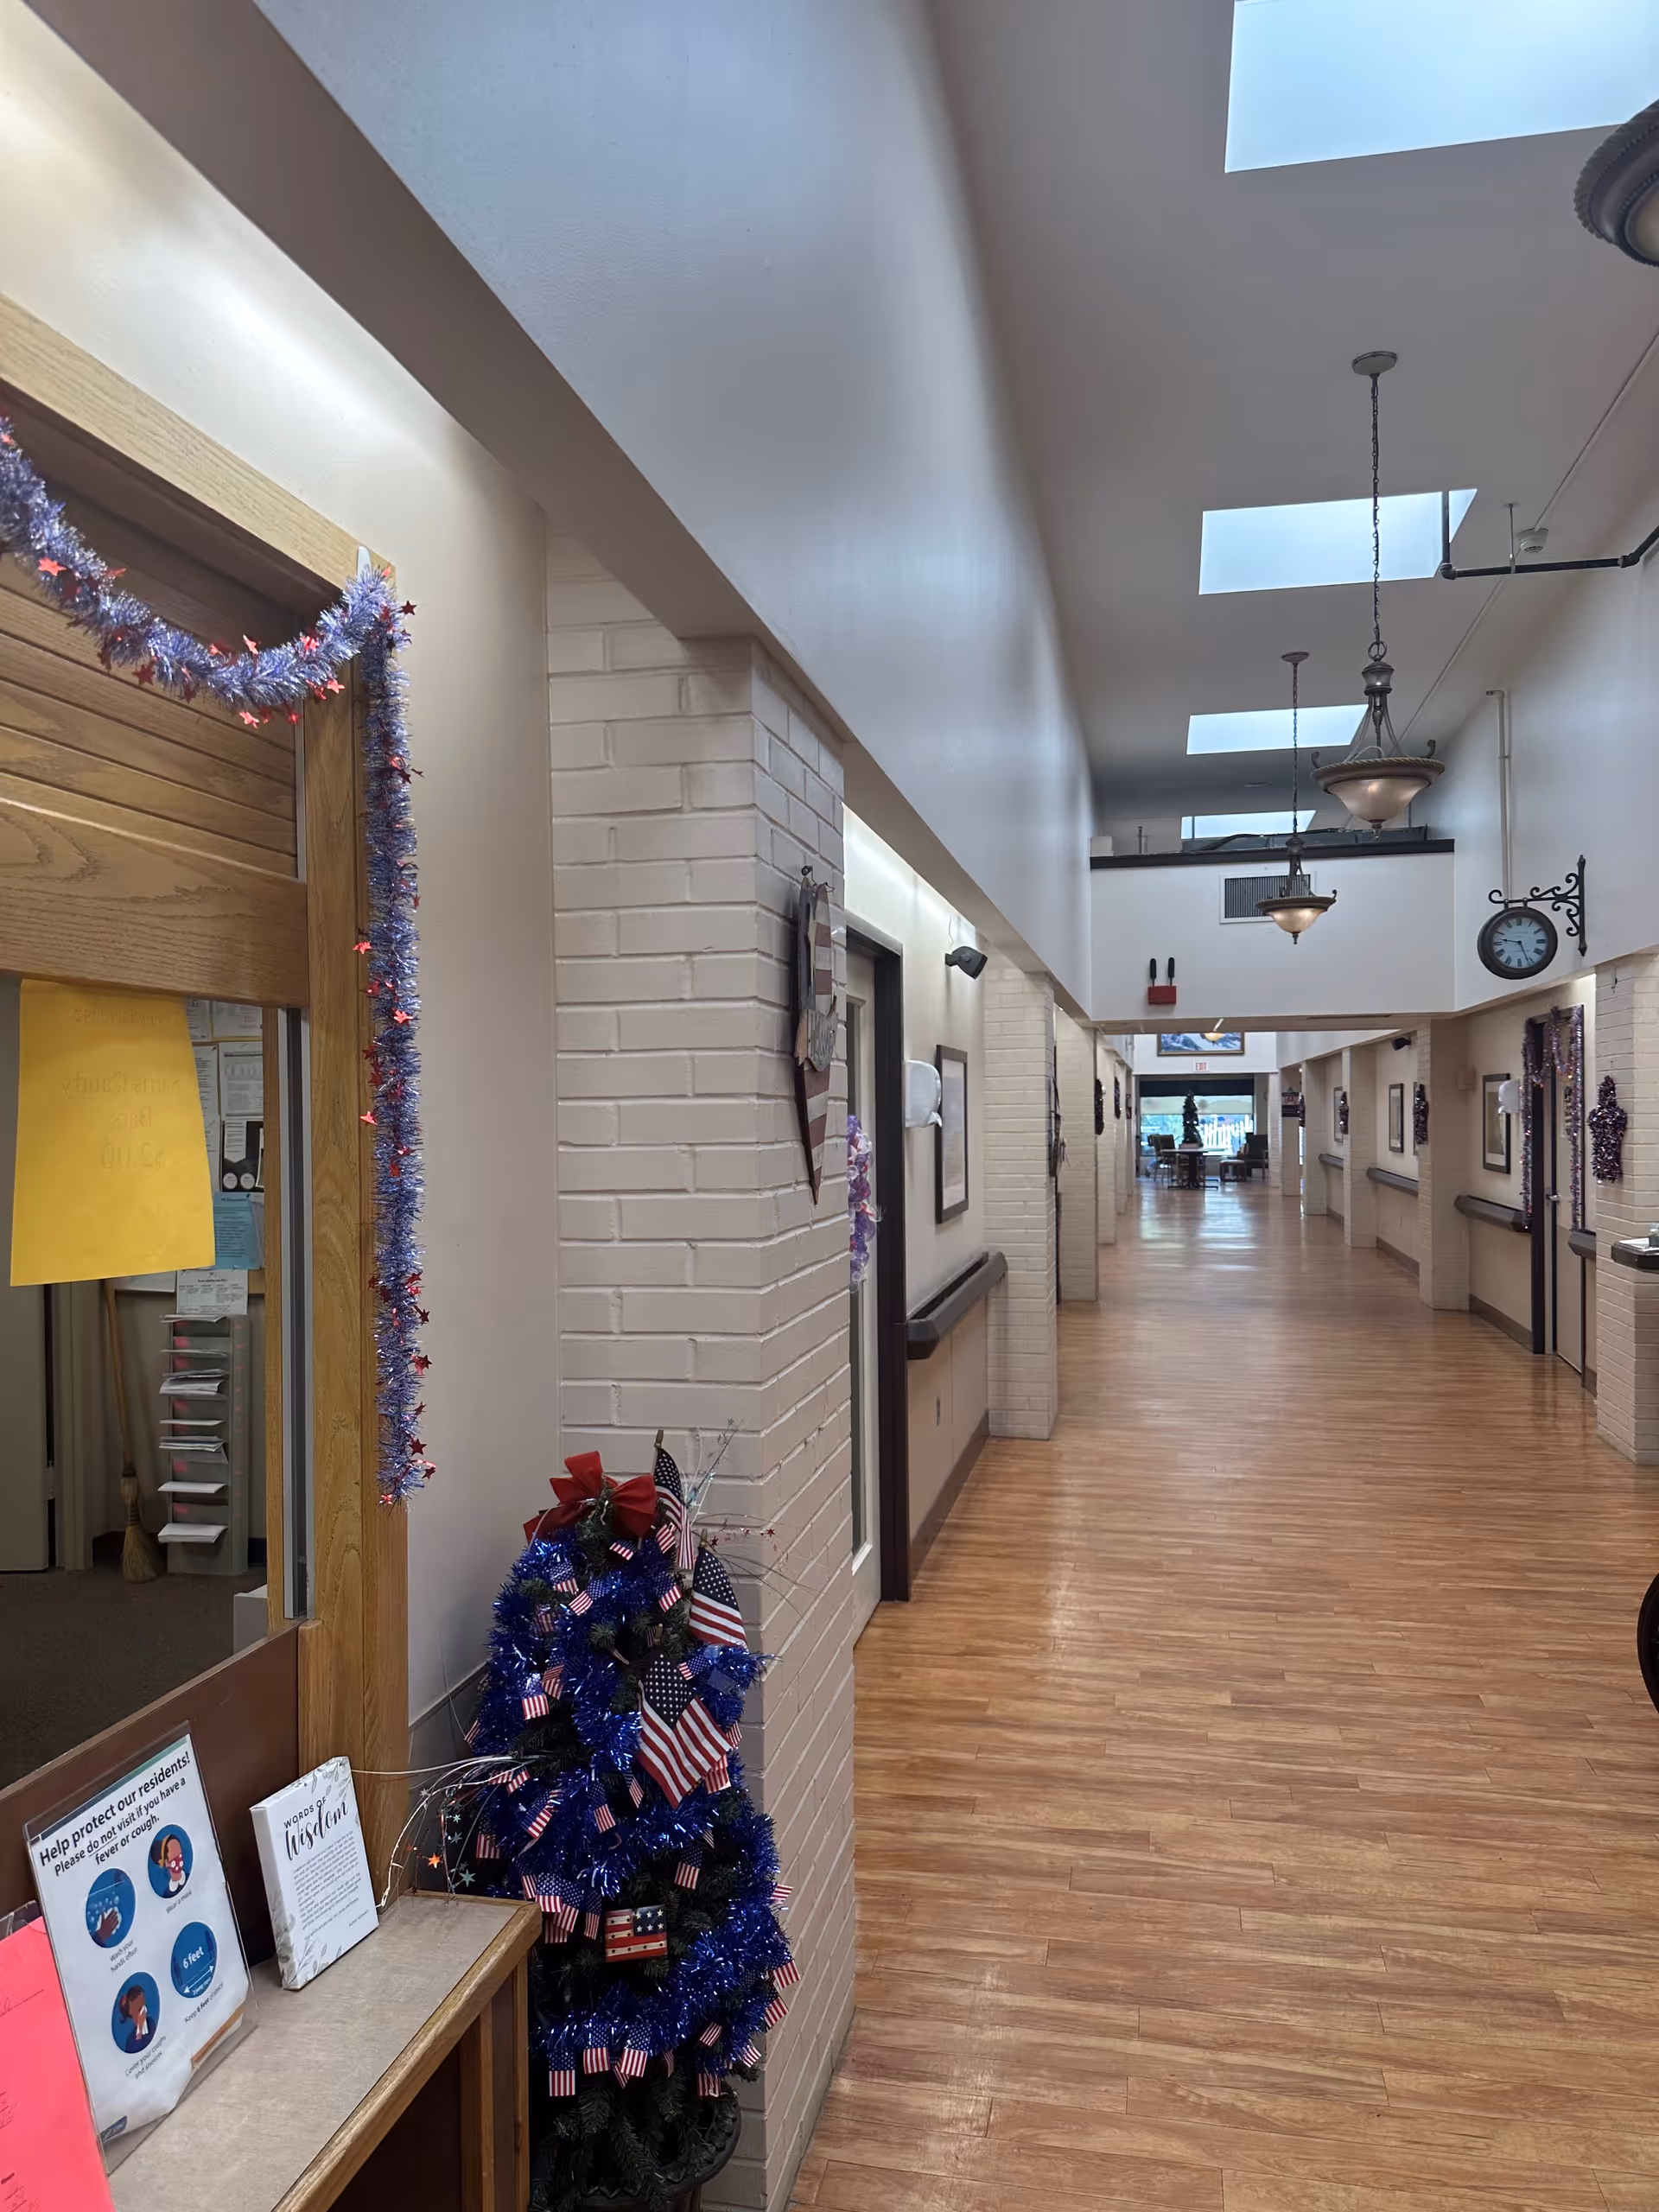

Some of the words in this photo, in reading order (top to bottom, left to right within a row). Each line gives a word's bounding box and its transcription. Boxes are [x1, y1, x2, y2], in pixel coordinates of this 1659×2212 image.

[40, 1838, 70, 1866] Help
[71, 1804, 115, 1847] protect
[118, 1790, 137, 1811] our
[138, 1751, 191, 1797] residents!
[54, 1848, 86, 1877] Please
[86, 1838, 99, 1854] do
[100, 1827, 118, 1843] not
[117, 1813, 137, 1832] visit
[137, 1806, 143, 1819] if
[143, 1796, 160, 1815] you
[160, 1783, 180, 1801] have
[180, 1777, 186, 1787] a
[283, 1804, 315, 1829] WORDS
[316, 1796, 327, 1808] OF
[285, 1800, 349, 1861] Wisdom
[95, 1846, 119, 1866] fever
[120, 1835, 130, 1847] or
[131, 1816, 160, 1840] cough.
[109, 1948, 124, 1962] Wash
[182, 1957, 188, 1968] 6
[188, 1946, 204, 1965] feet
